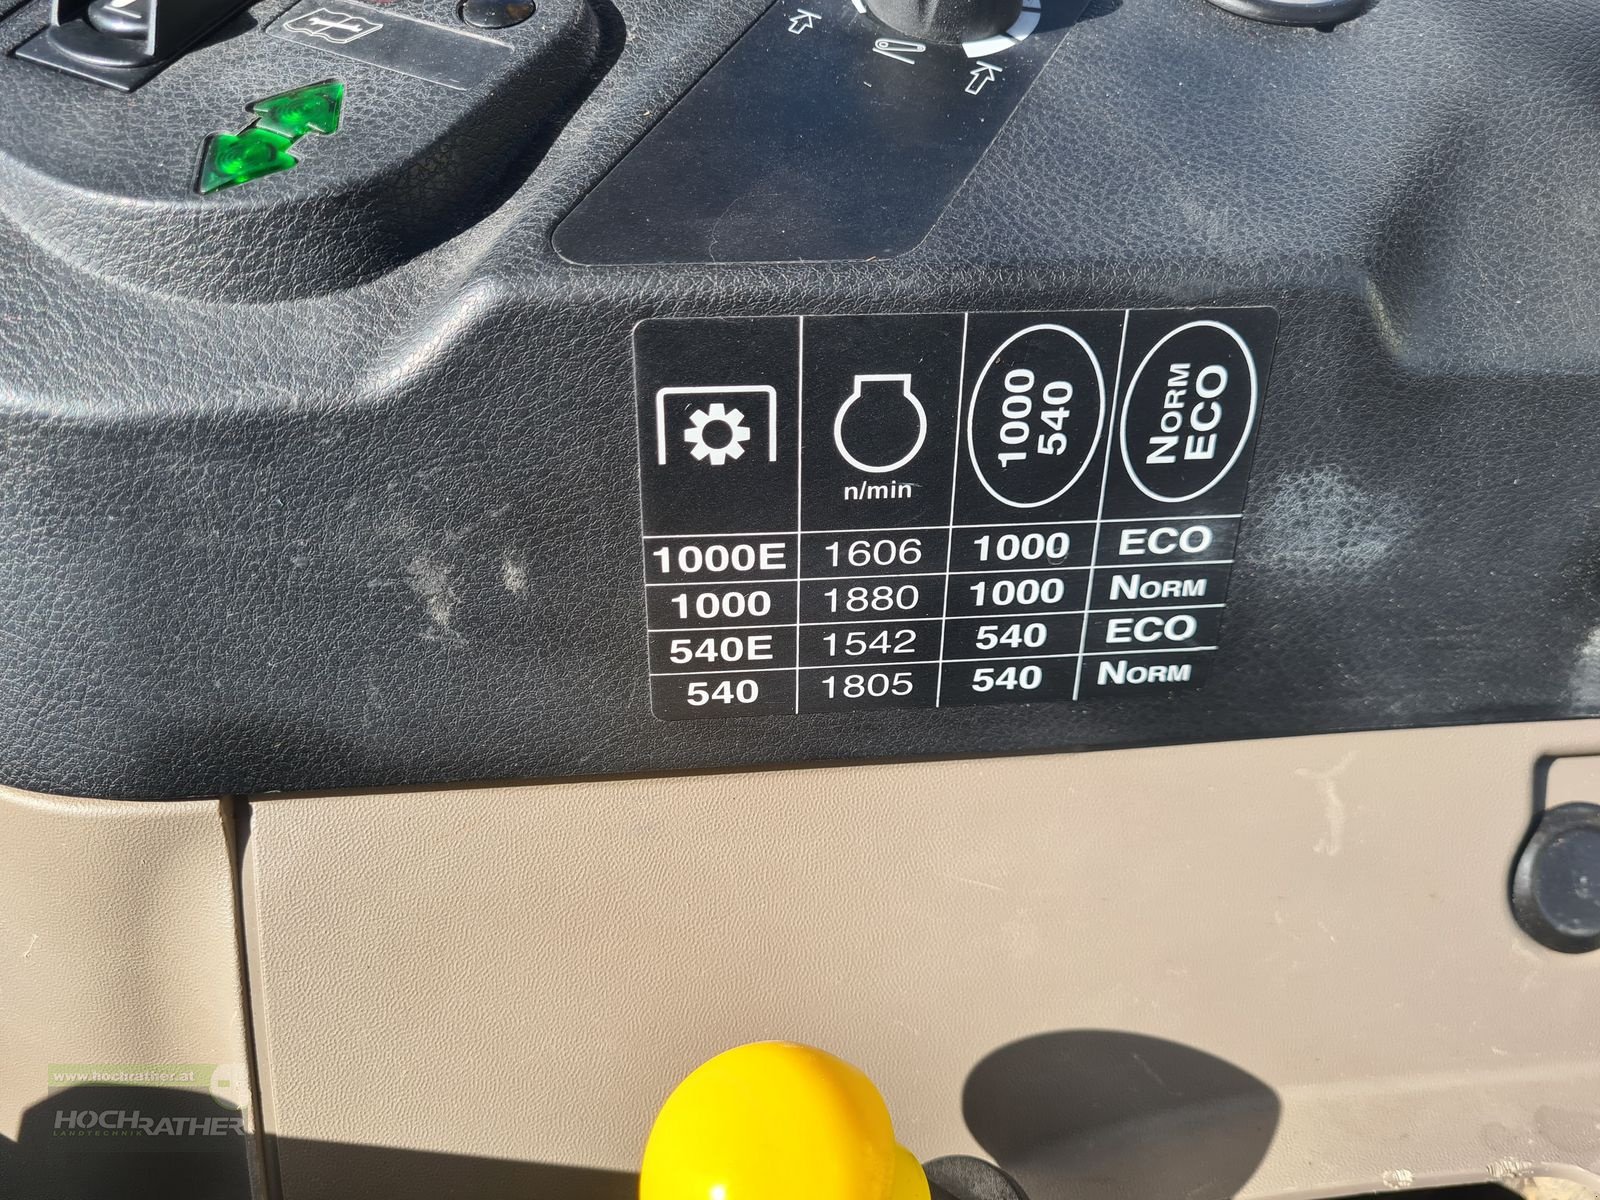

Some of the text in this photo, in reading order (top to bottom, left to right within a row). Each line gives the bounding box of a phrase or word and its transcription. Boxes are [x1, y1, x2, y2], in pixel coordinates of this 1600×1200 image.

[998, 368, 1035, 468] 1000
[1037, 381, 1073, 456] 540
[1184, 364, 1229, 460] ECO
[844, 480, 912, 500] n/min
[825, 538, 922, 567] 1606
[973, 532, 1070, 561] 1000
[1119, 525, 1213, 556] ECO
[653, 542, 786, 573] 1000E
[671, 591, 771, 619] 1000
[824, 585, 919, 612] 1880
[970, 578, 1065, 606] 1000
[823, 629, 917, 656] 1542
[975, 623, 1047, 650] 540
[1105, 615, 1198, 643] ECO
[669, 635, 773, 664] 540E
[687, 679, 759, 706] 540
[822, 672, 913, 699] 1805
[971, 665, 1042, 692] 540
